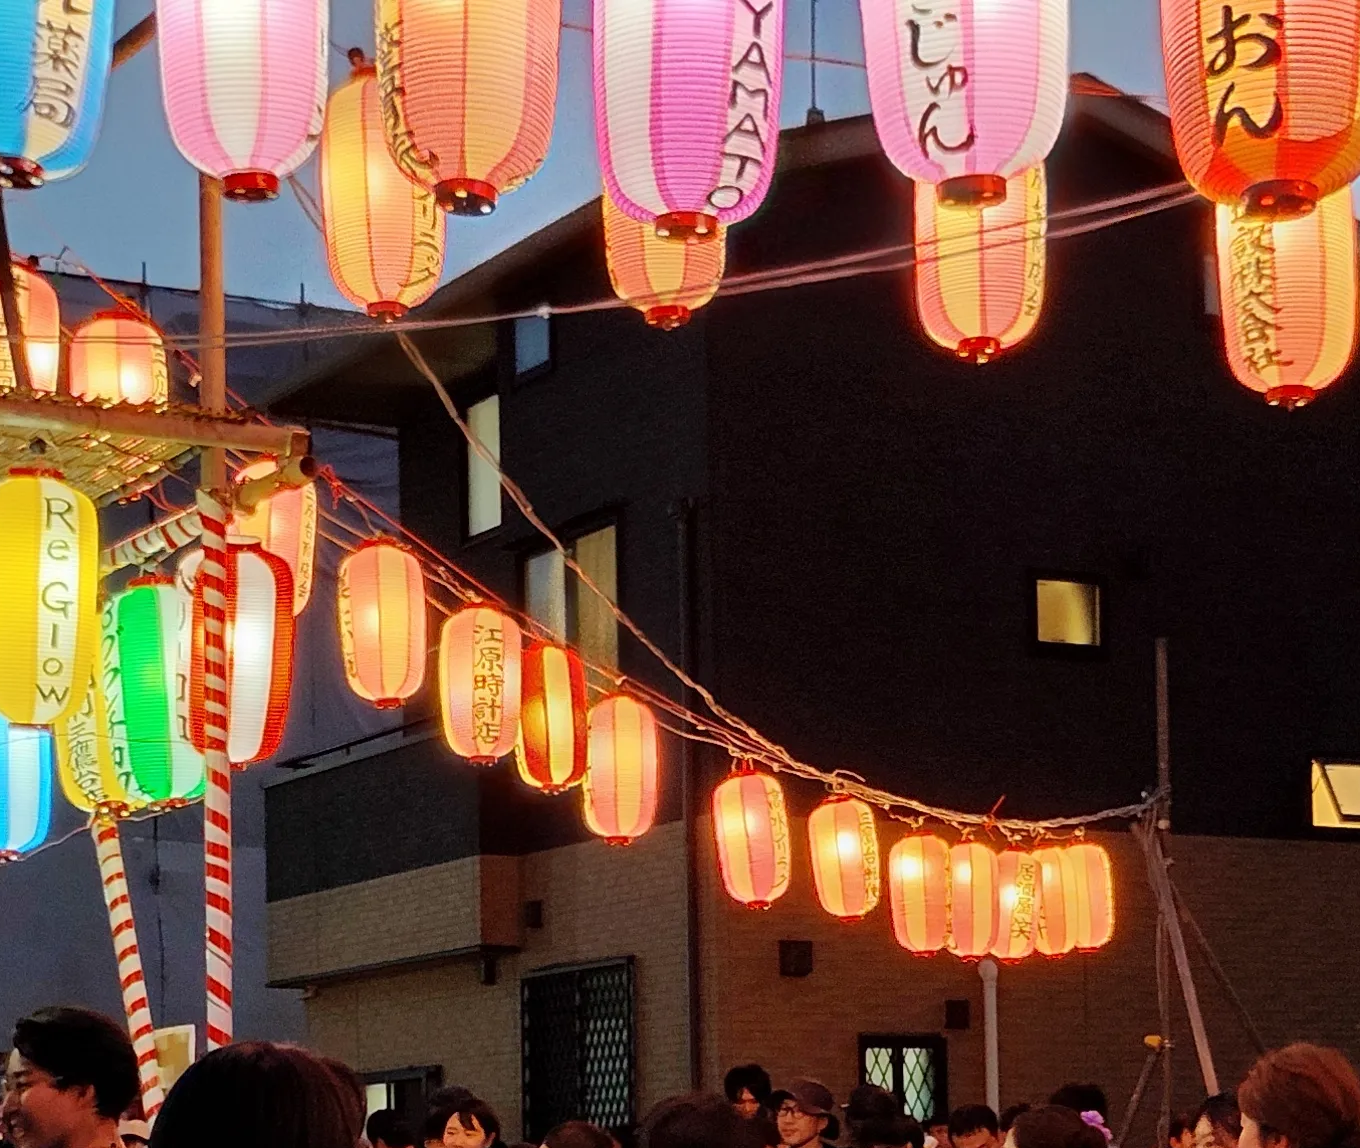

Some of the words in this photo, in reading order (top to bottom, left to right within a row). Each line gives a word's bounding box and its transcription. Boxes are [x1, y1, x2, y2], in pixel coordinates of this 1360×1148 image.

[16, 0, 92, 129] 薬局
[707, 2, 774, 209] YAMATO
[905, 4, 977, 160] じゅん
[472, 621, 505, 746] 江原時計店
